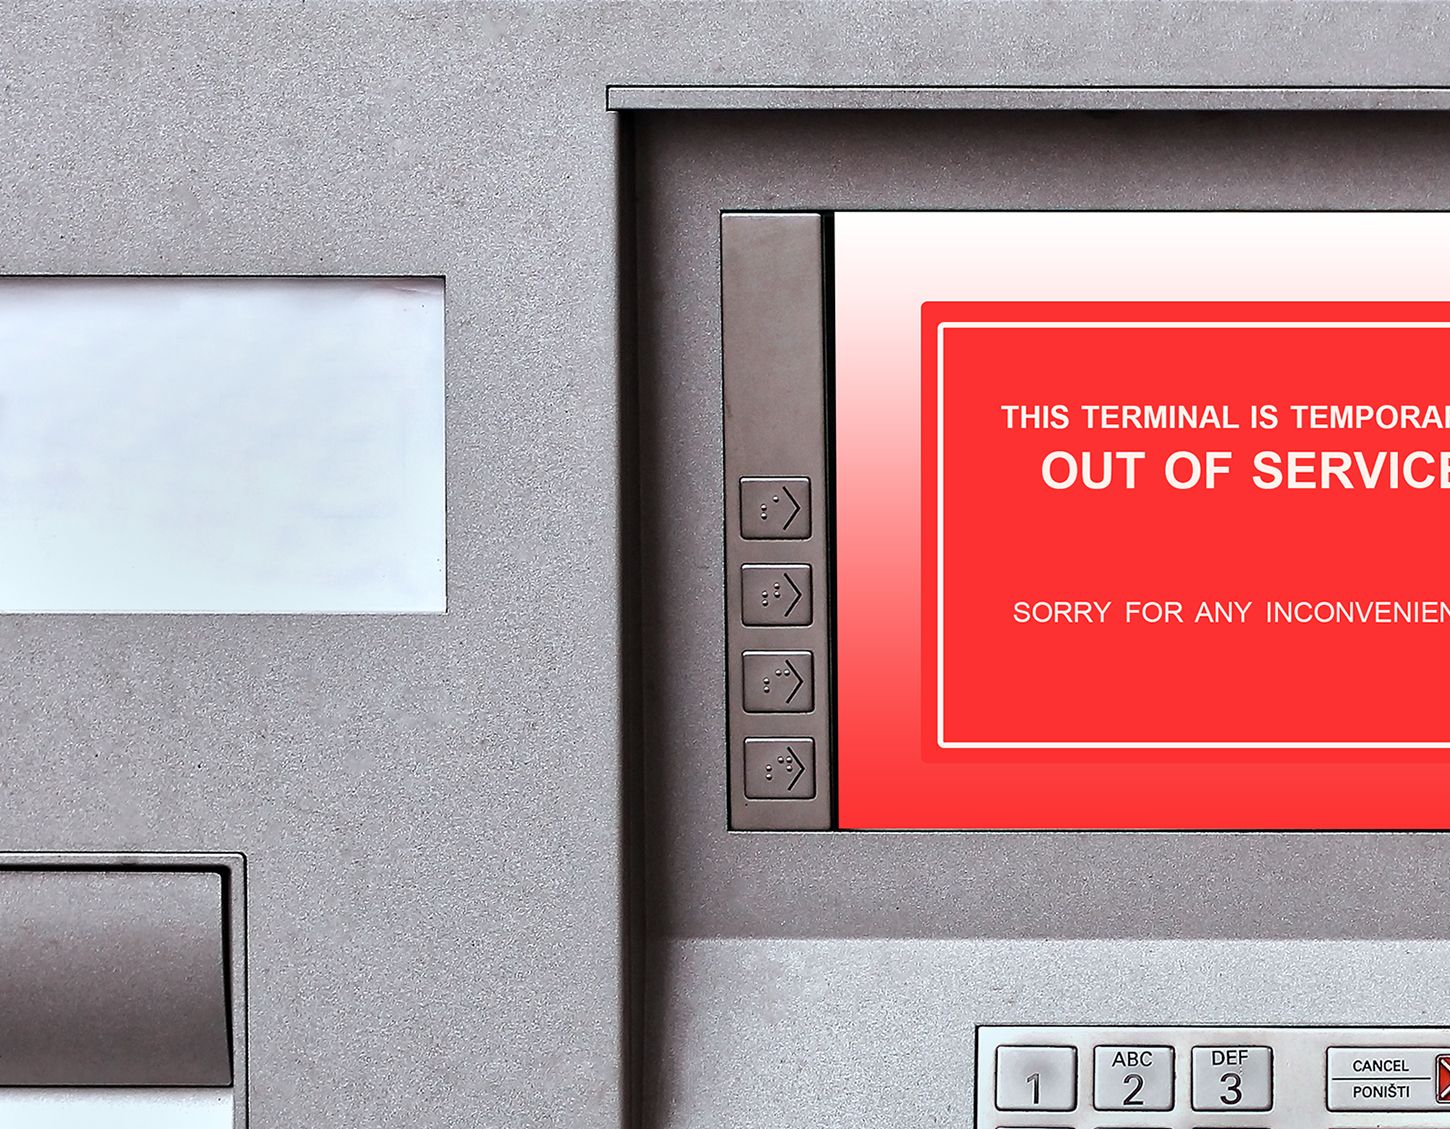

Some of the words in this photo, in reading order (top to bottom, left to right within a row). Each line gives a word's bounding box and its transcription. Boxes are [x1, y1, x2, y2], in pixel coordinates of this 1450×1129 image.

[1000, 404, 1070, 430] THIS
[1081, 405, 1240, 429] TERMINAL
[1251, 404, 1279, 430] IS
[1041, 450, 1146, 490] OUT
[1164, 450, 1233, 490] OF
[1013, 601, 1112, 623] SORRY
[1126, 601, 1184, 623] FOR
[1194, 601, 1253, 623] ANY
[1111, 1050, 1153, 1068] ABC
[1211, 1049, 1249, 1066] DEF
[1352, 1059, 1410, 1073] CANCEL
[1024, 1072, 1041, 1106] 1
[1122, 1073, 1144, 1106] 2
[1219, 1072, 1243, 1105] 3
[1353, 1082, 1410, 1099] PONIŠTI
